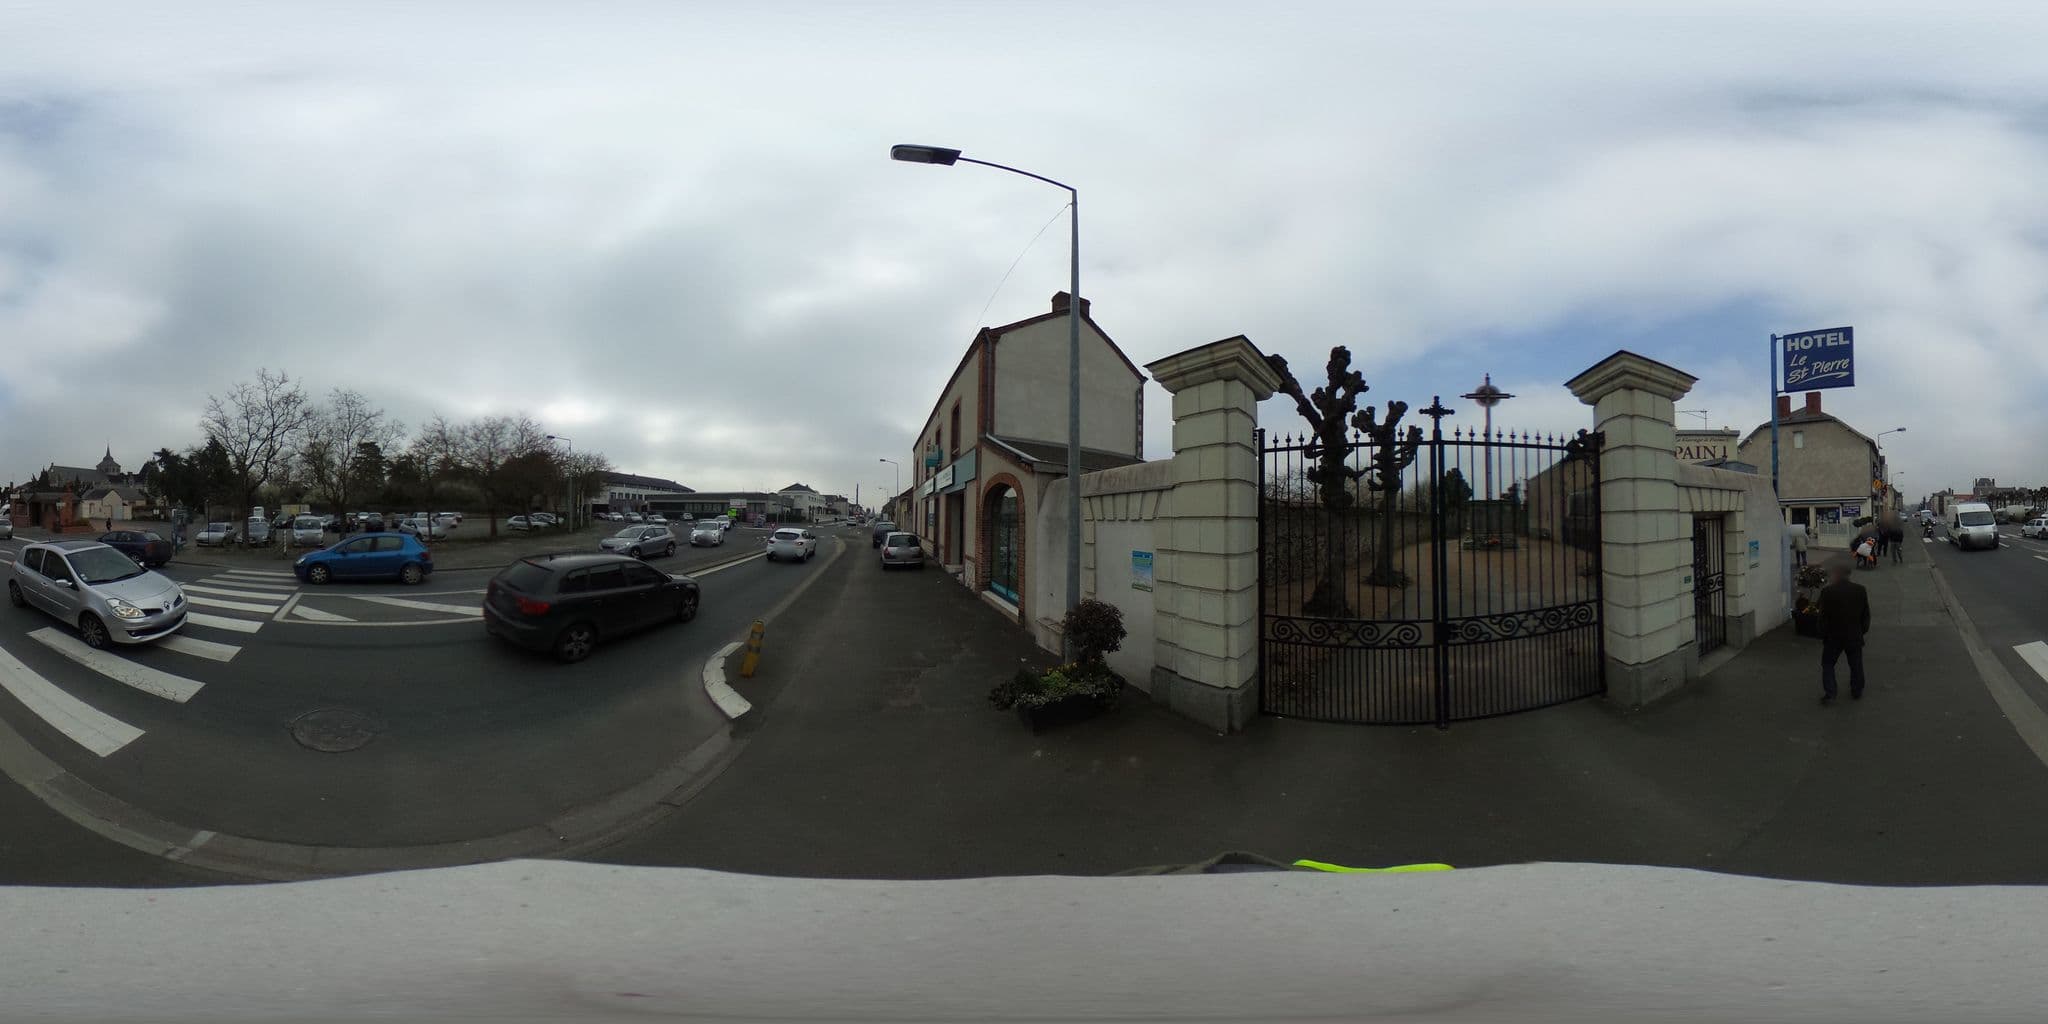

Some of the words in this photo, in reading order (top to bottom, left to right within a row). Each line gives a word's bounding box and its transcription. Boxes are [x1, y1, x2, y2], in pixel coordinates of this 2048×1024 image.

[1786, 332, 1850, 352] HOTEL
[1790, 354, 1808, 367] Le
[1786, 367, 1809, 384] St
[1811, 358, 1850, 375] Pierre
[1674, 445, 1717, 460] PAIN
